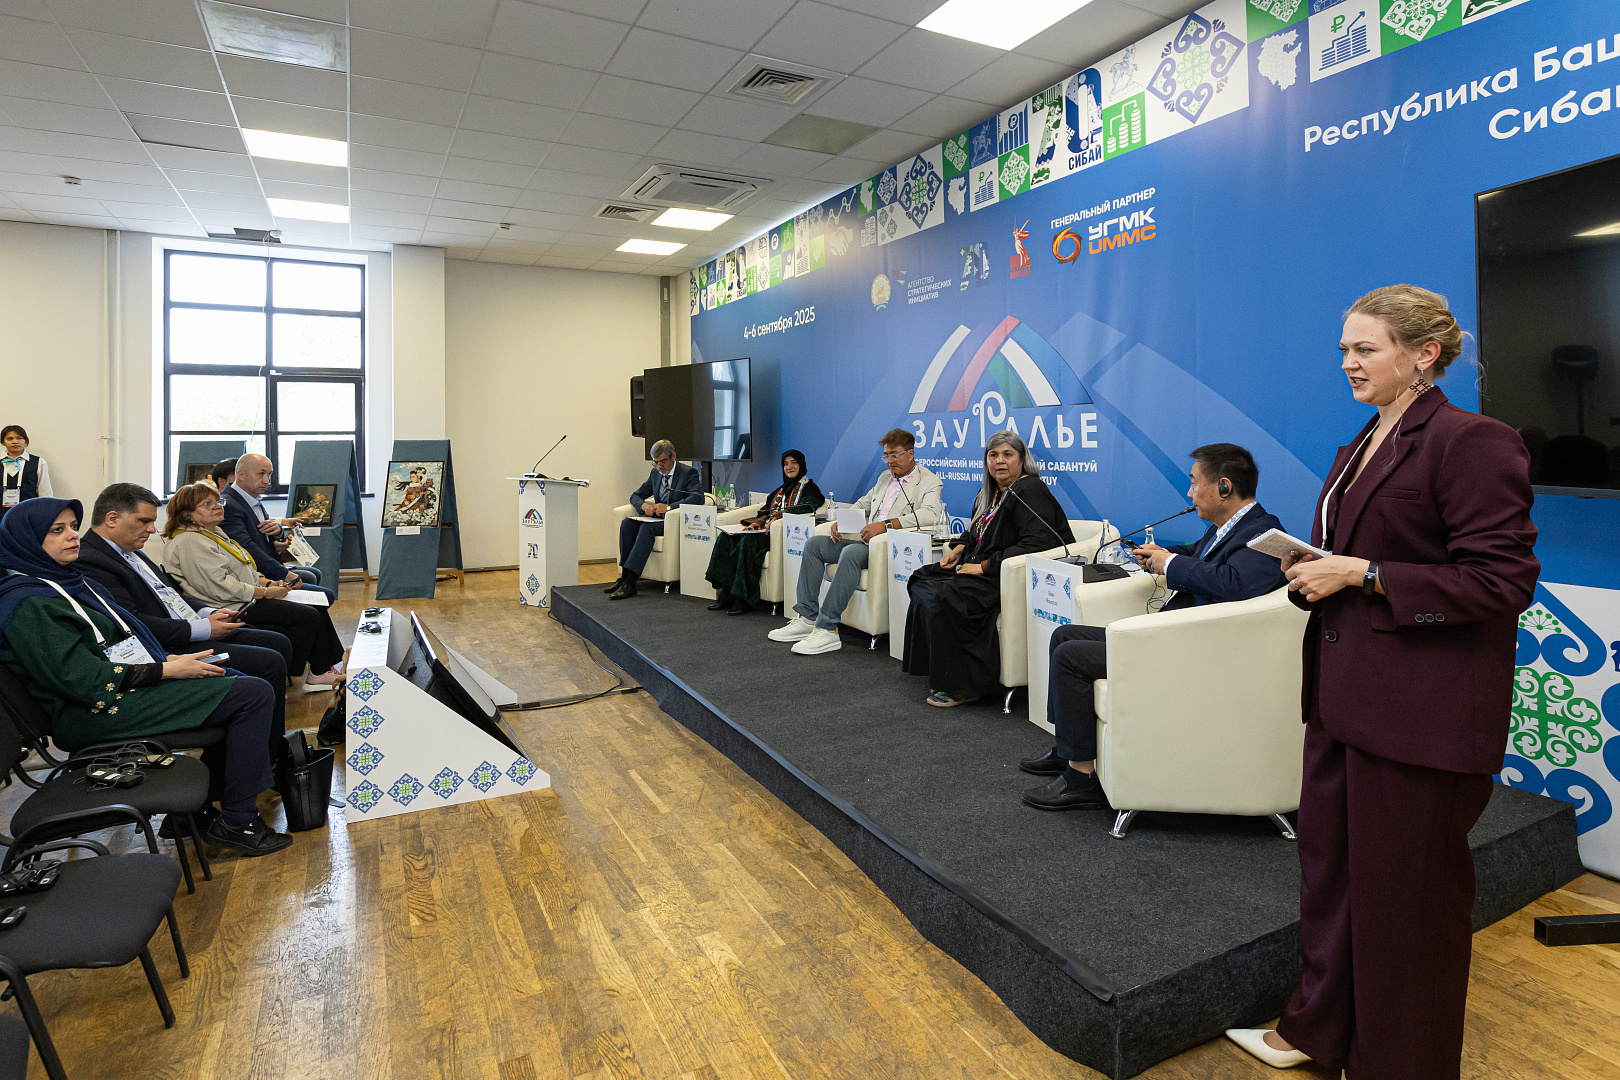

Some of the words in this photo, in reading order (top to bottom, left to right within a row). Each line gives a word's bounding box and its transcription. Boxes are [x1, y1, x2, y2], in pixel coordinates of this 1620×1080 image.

[1304, 67, 1518, 152] Республика
[1489, 85, 1620, 140] Сиба
[1068, 144, 1102, 170] СИБАЙ
[1051, 200, 1111, 229] ГЕНЕРАЛЬНЫЙ
[1112, 187, 1156, 210] ПАРТНЕР
[1088, 207, 1156, 240] УГМК
[1088, 224, 1156, 255] UMMC
[908, 276, 935, 289] АГЕНТСТВО
[908, 279, 952, 297] СТРАТЕГИЧЕСКИХ
[908, 291, 939, 305] ИНИЦИАТИВ
[743, 323, 757, 339] 4-6
[757, 315, 793, 336] сентября
[794, 306, 816, 327] 2025
[1047, 460, 1098, 473] САБАНТУЙ
